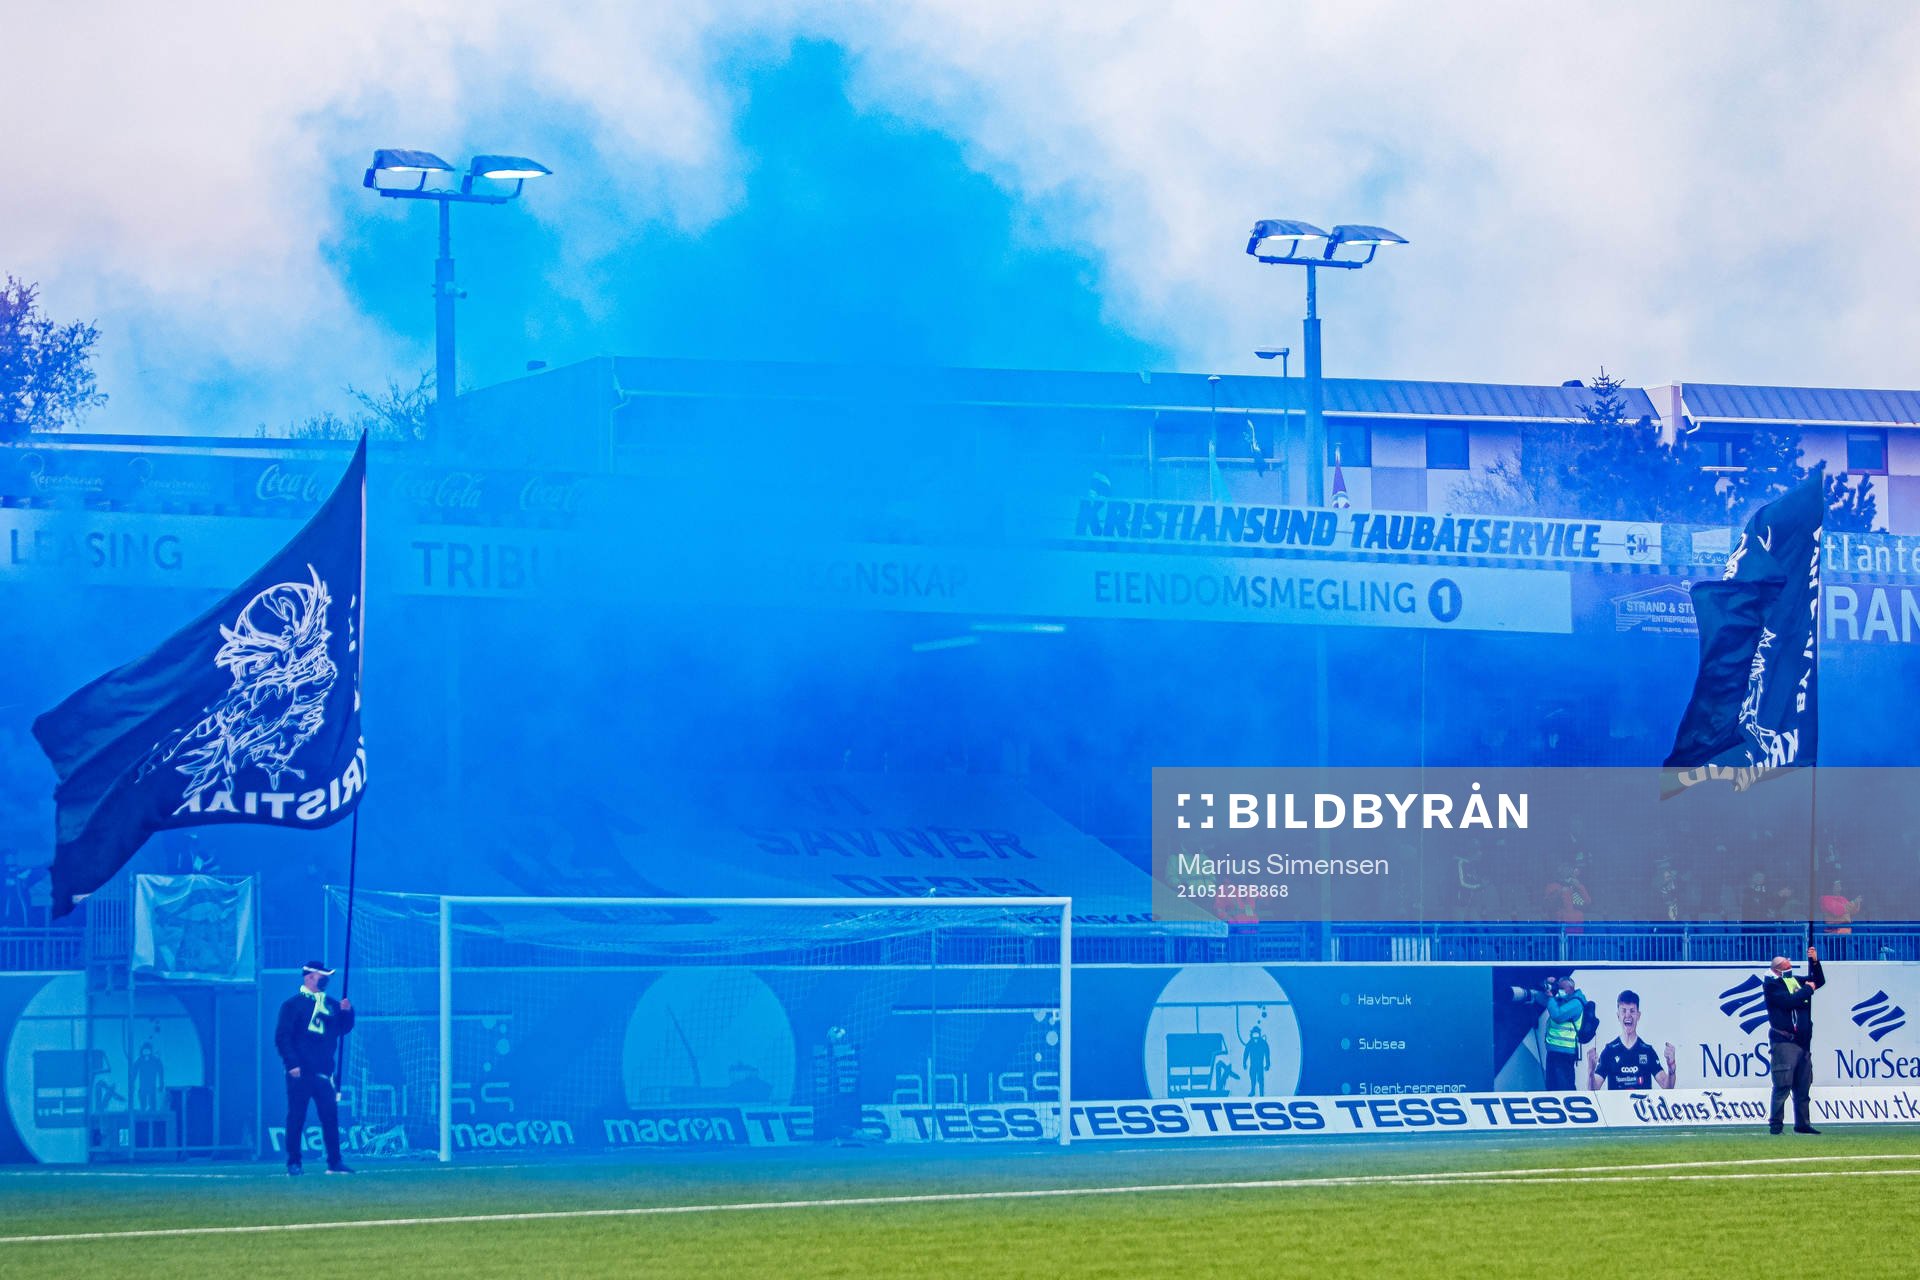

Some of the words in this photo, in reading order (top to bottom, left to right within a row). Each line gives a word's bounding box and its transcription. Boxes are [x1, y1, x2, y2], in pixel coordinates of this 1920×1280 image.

[1075, 500, 1337, 547] KRISTIANSUND
[1350, 512, 1601, 559] TAUBÅTSERVICE
[11, 529, 183, 570] LEASING
[1094, 571, 1417, 614] EIENDOMSMEGLING
[1627, 601, 1666, 613] STRAND
[1669, 603, 1676, 613] &
[737, 826, 1038, 859] SAVNER
[1358, 994, 1412, 1005] Havbruk
[1359, 1038, 1406, 1050] Subsea
[1700, 1043, 1771, 1077] NorS
[1835, 1049, 1920, 1079] NorSea
[1052, 1103, 1189, 1136] TESS
[1191, 1101, 1325, 1132] TESS
[1336, 1098, 1468, 1129] TESS
[1470, 1096, 1599, 1125] TESS
[1630, 1093, 1710, 1123] Tidens
[1703, 1091, 1767, 1120] Krav
[450, 1119, 575, 1147] macron
[604, 1119, 735, 1145] macron
[901, 1108, 1043, 1142] TESS
